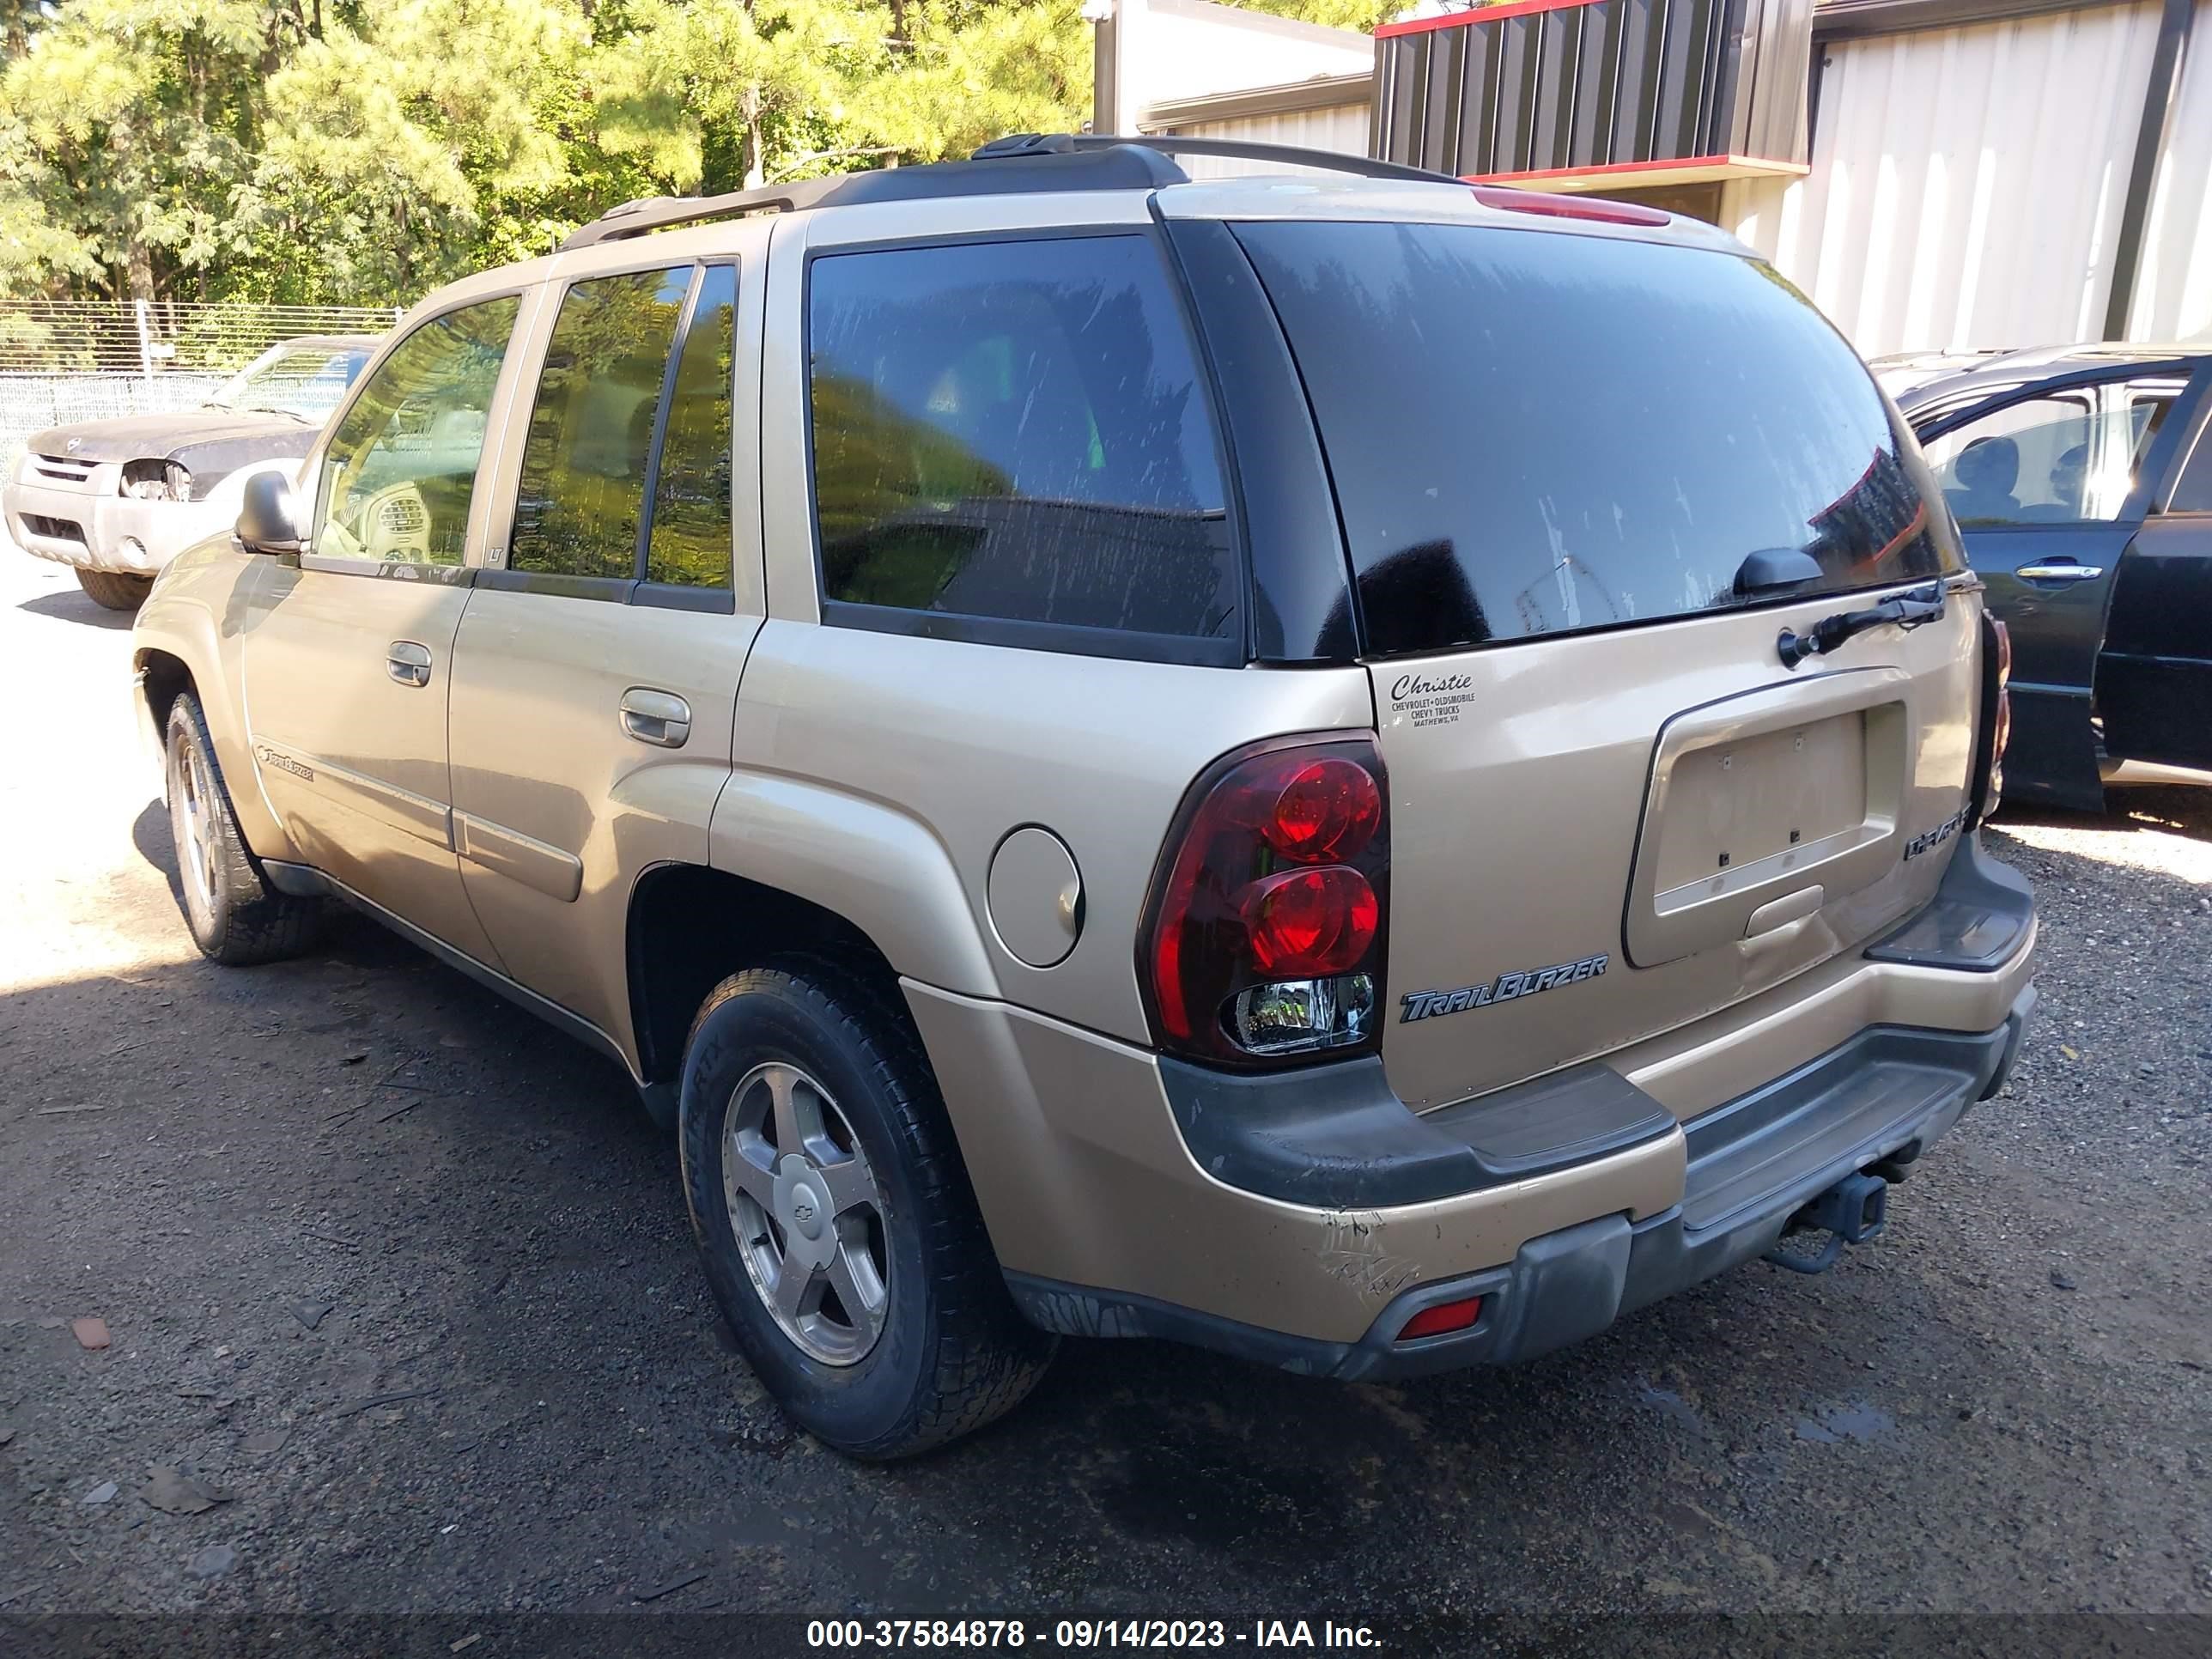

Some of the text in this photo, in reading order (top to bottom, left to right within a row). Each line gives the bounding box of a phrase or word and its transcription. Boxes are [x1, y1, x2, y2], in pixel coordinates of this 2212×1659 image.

[1391, 673, 1474, 701] Christie
[1411, 705, 1460, 720] CHEVY TRUCKS
[1904, 803, 1972, 861] CHEVROLE
